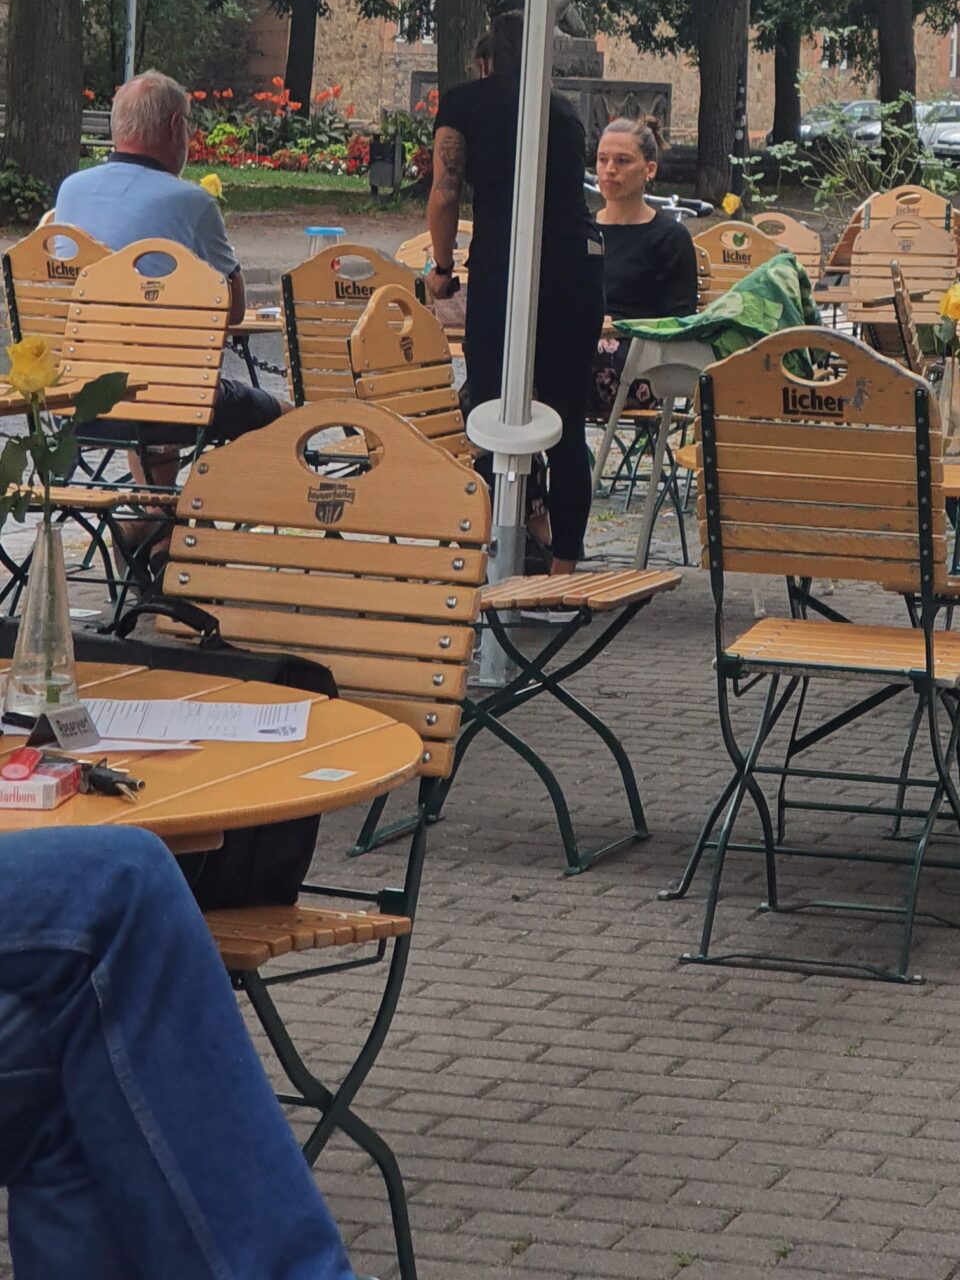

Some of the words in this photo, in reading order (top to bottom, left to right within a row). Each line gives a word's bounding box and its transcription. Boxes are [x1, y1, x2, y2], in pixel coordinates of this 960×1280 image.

[722, 249, 752, 265] Licher
[46, 260, 81, 280] Licher
[334, 280, 376, 300] Licher
[782, 386, 846, 418] Licher
